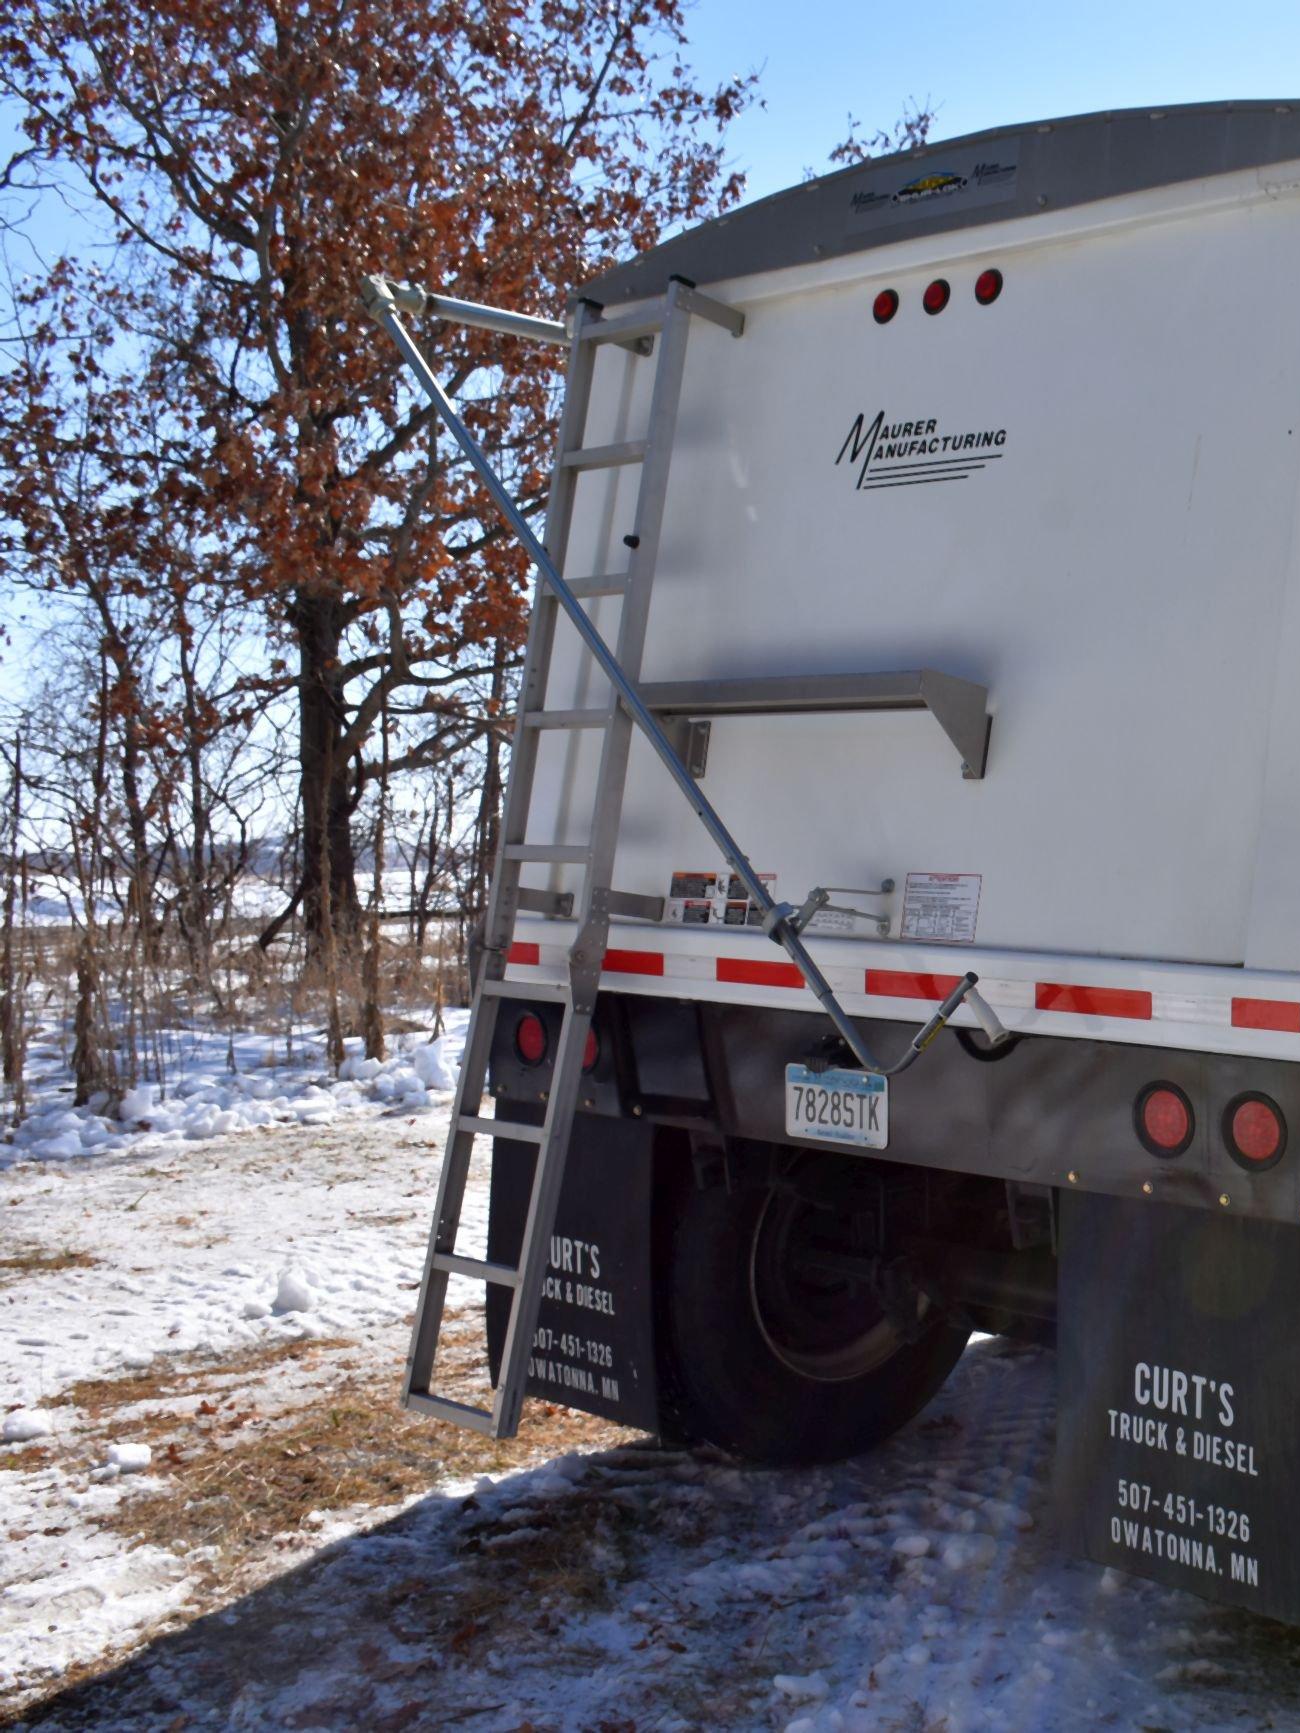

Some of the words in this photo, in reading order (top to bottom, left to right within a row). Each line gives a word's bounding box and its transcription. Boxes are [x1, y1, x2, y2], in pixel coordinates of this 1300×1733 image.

[835, 410, 937, 490] MAURER
[793, 1086, 879, 1132] 7828STK
[550, 1235, 600, 1279] URT'S
[566, 1281, 573, 1304] &
[576, 1283, 615, 1316] DIESEL
[602, 1376, 620, 1401] MN
[1134, 1361, 1235, 1427] CURT'S
[1108, 1409, 1168, 1451] TRUCK
[1175, 1426, 1187, 1456] &
[1193, 1431, 1259, 1476] DIESEL
[1118, 1478, 1250, 1543] 507-451-1326
[1230, 1551, 1259, 1587] MN
